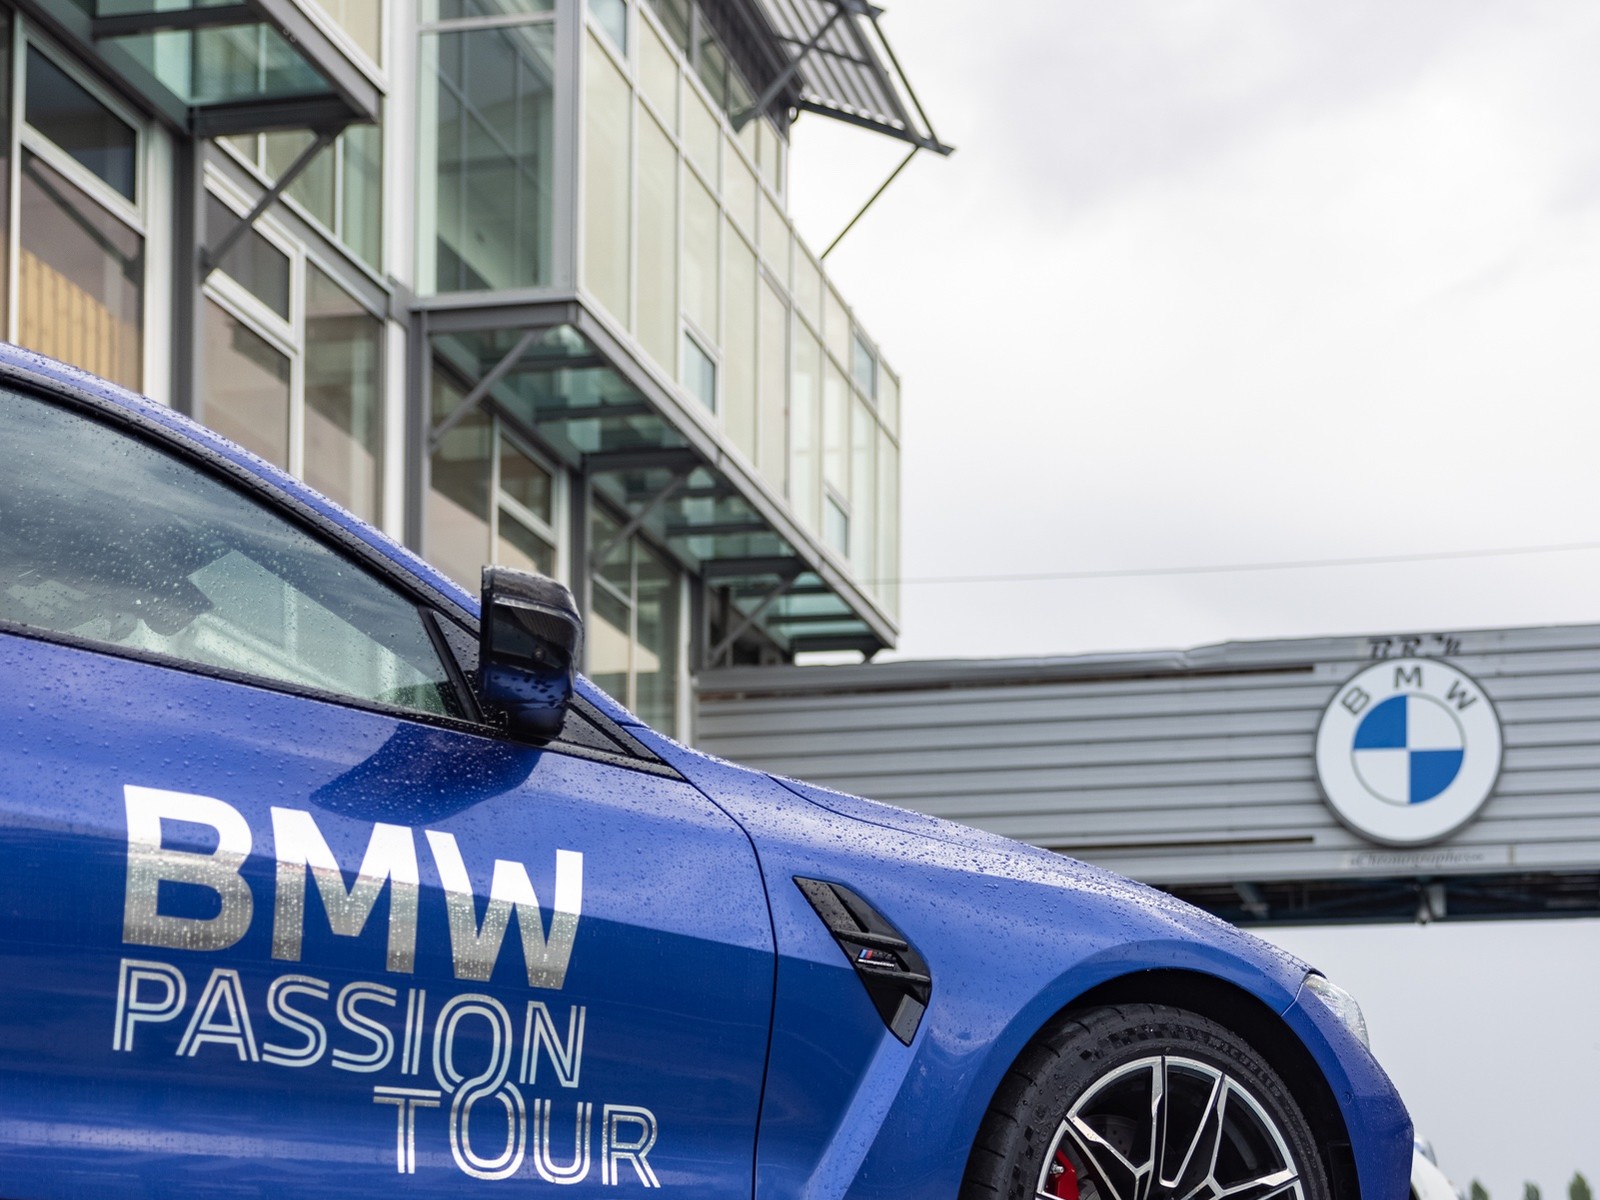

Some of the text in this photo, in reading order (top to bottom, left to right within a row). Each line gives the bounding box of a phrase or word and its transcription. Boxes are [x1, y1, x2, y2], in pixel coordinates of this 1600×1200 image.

[1340, 666, 1478, 716] BMW
[122, 784, 584, 990] BMW
[112, 957, 587, 1090] PASSION
[373, 1078, 661, 1188] TOUR
